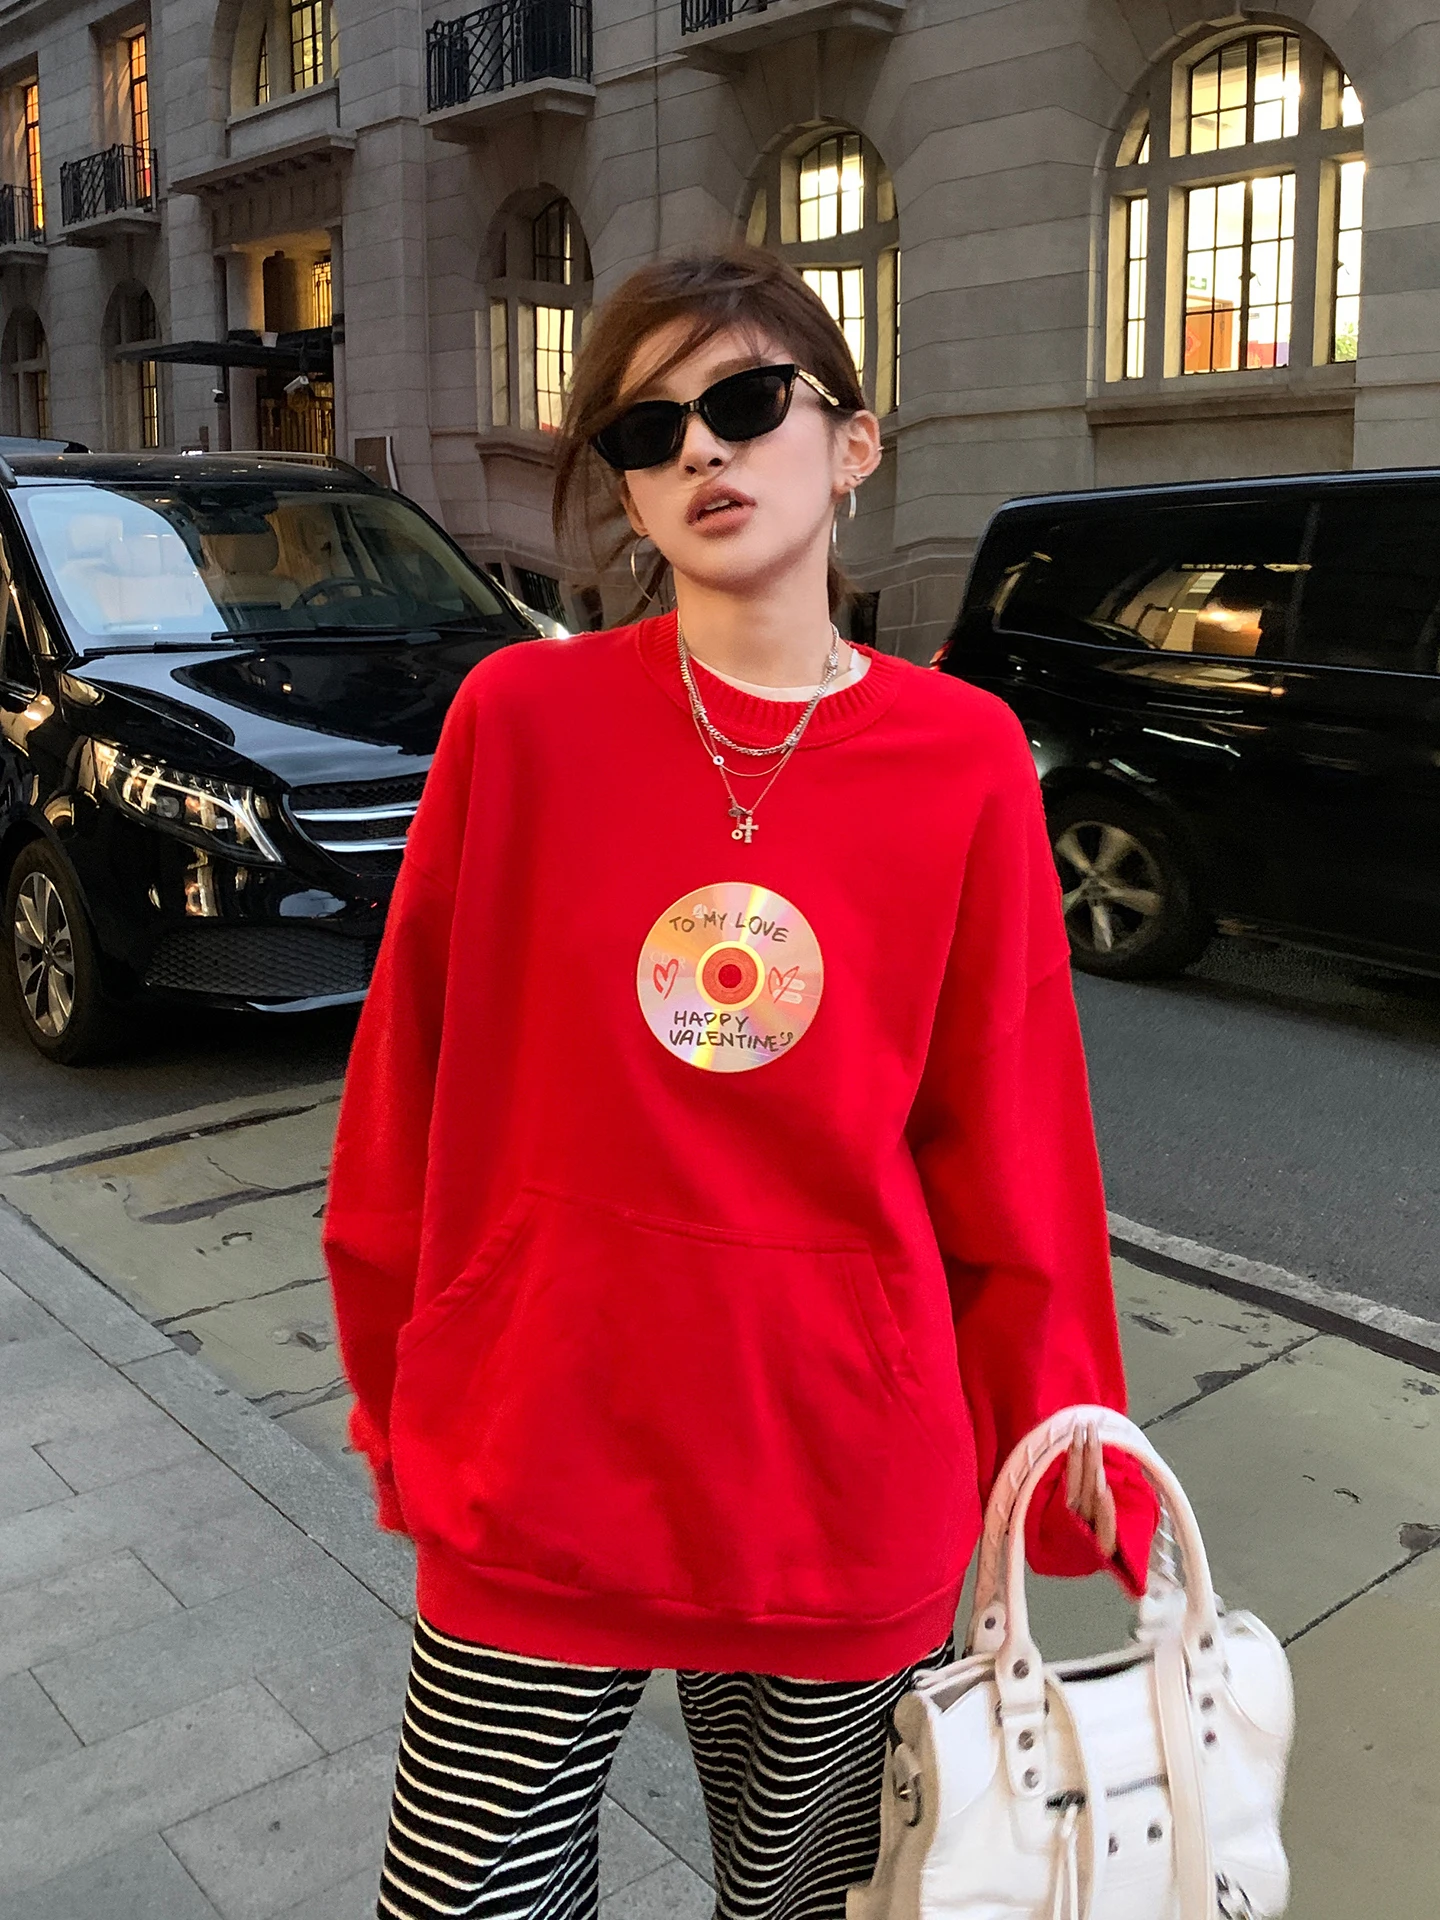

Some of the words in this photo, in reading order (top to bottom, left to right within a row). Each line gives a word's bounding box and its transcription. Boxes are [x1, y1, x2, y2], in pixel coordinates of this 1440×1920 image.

[668, 915, 695, 933] TO
[703, 911, 728, 931] MY
[735, 912, 790, 943] LOVE
[673, 1010, 749, 1033] HAPPY
